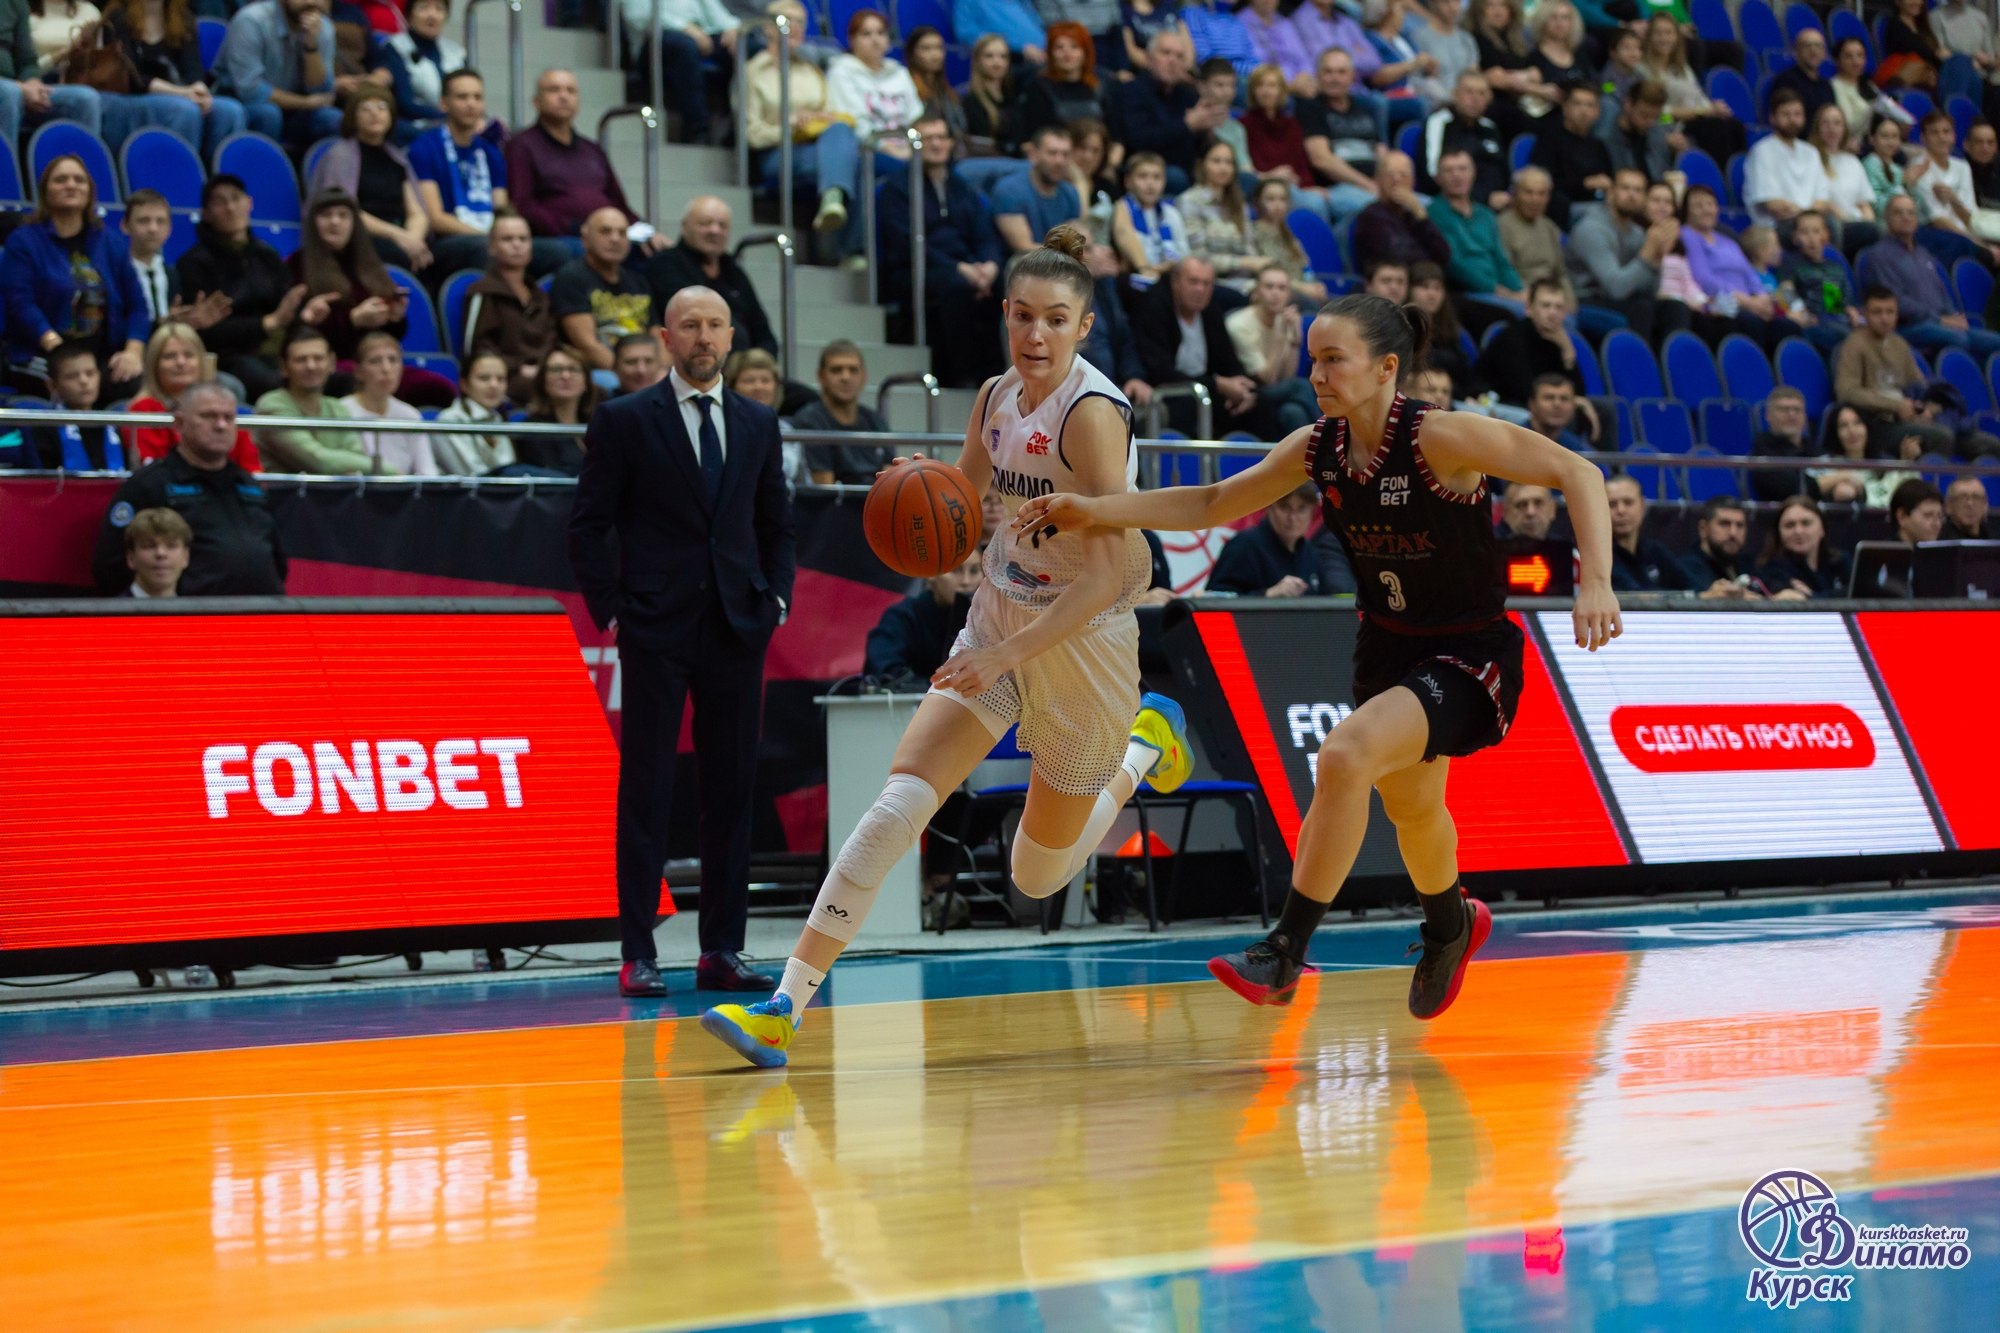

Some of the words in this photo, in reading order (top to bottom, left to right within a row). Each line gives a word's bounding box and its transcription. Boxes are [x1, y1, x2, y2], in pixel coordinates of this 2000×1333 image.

[1028, 430, 1053, 444] FON
[1026, 442, 1049, 456] BET
[1379, 475, 1409, 491] FON
[1380, 490, 1411, 506] BET
[1379, 570, 1407, 612] 3
[1635, 725, 1744, 755] СДЕЛАТЬ
[1743, 722, 1854, 750] ПРОГНОЗ
[202, 736, 532, 818] FONBET
